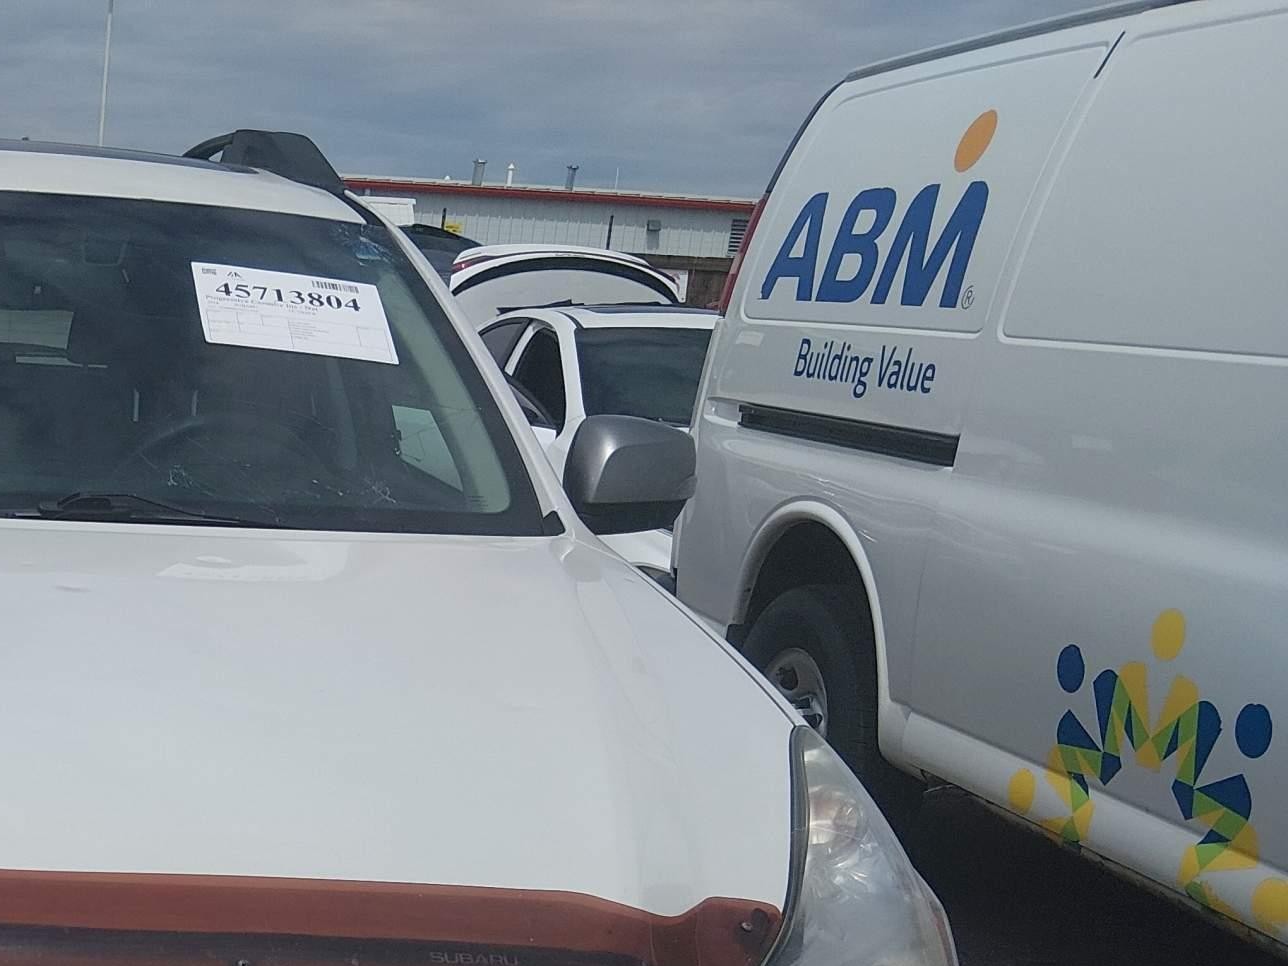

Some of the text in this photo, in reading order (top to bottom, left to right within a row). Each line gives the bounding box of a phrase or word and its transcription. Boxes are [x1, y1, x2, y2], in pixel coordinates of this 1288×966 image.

[760, 181, 989, 308] ABM
[215, 282, 361, 312] 45713804
[793, 338, 936, 398] Building Value
[430, 952, 519, 966] SUBARU
